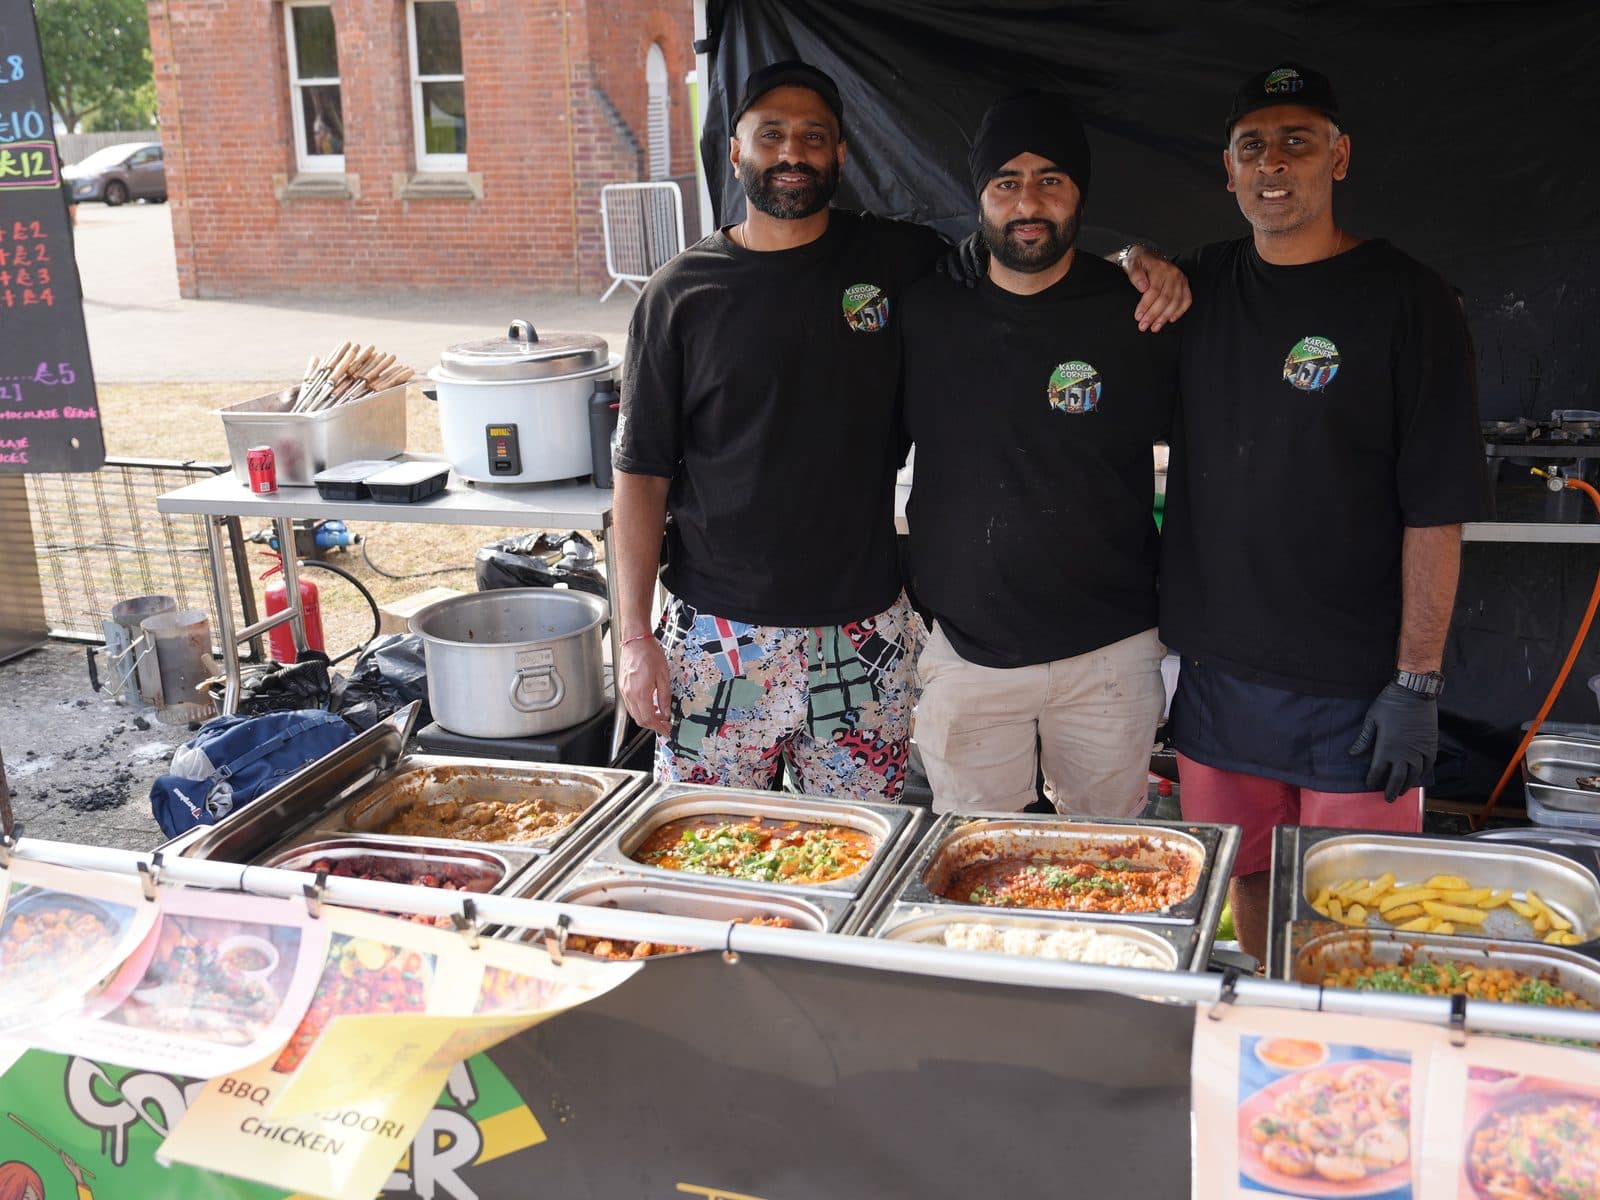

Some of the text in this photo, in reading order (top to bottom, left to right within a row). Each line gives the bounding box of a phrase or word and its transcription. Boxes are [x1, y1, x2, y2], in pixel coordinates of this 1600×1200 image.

[0, 54, 24, 83] 8
[845, 284, 877, 295] KAROGA
[849, 290, 879, 302] CORNER
[1302, 344, 1332, 360] CORNER
[1304, 336, 1335, 352] KAROGA
[1058, 363, 1093, 371] KAROGA
[1060, 371, 1093, 380] CORNER
[218, 1077, 271, 1106] BBQ
[240, 1116, 345, 1155] CHICKEN
